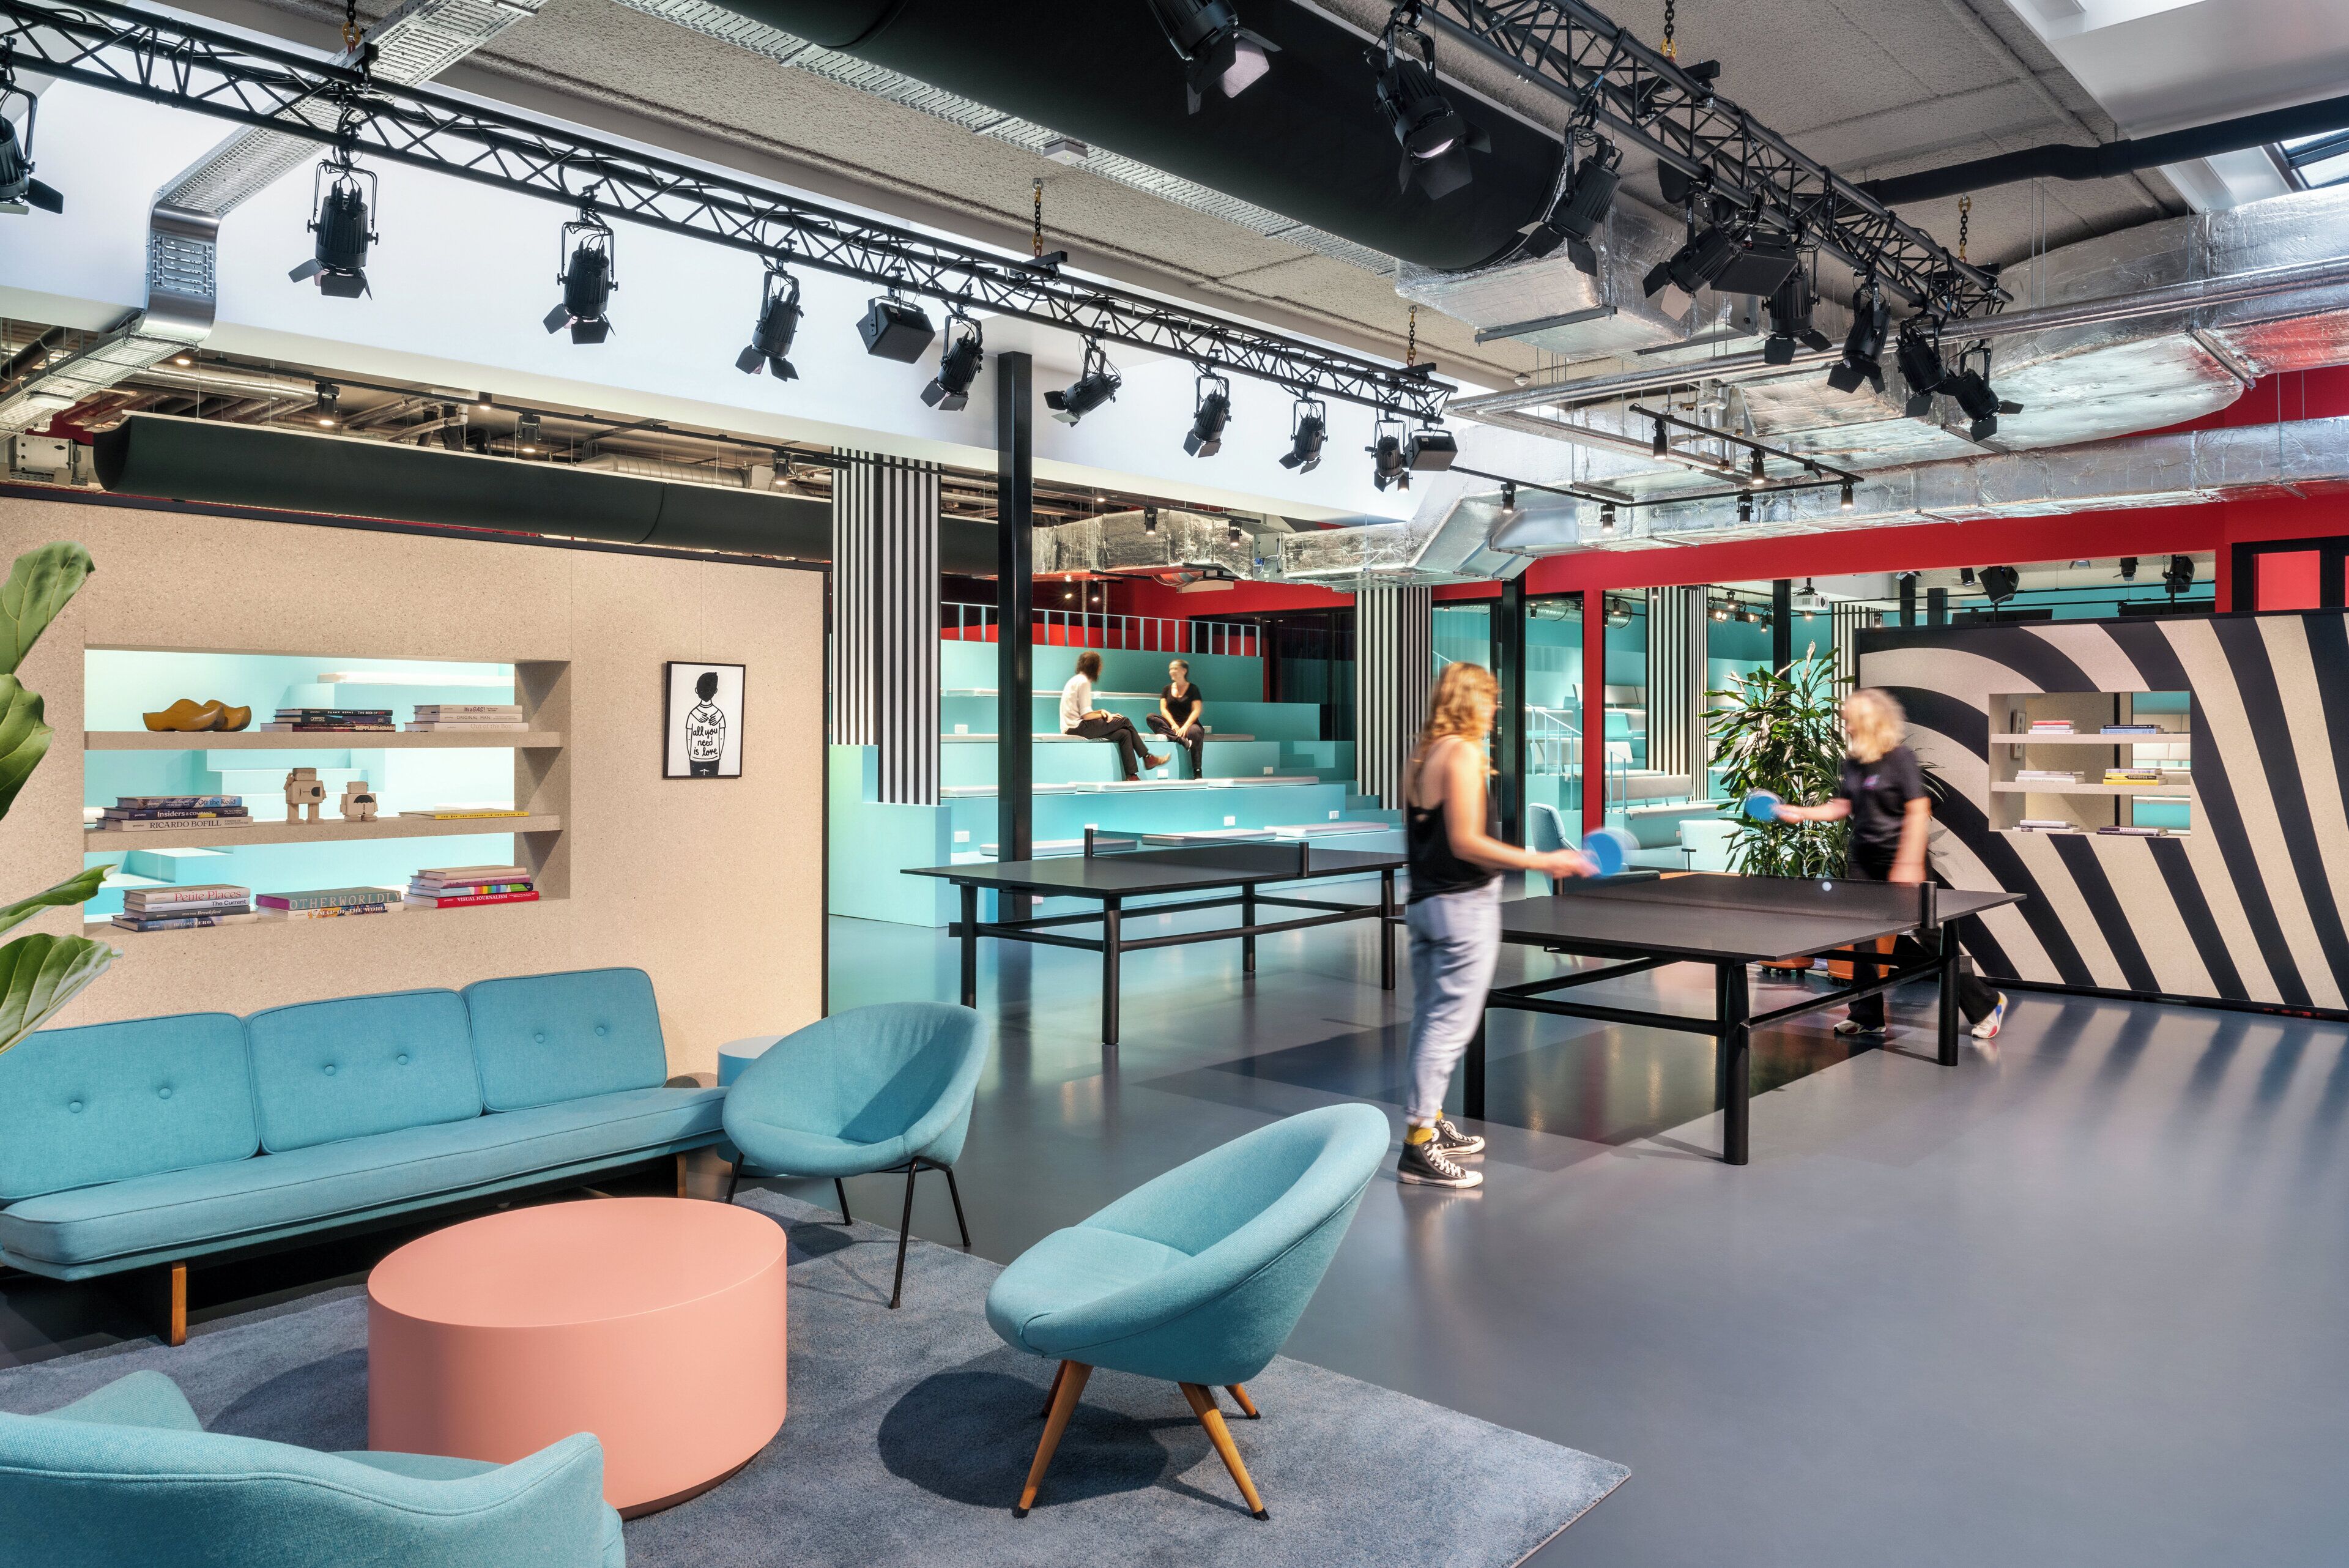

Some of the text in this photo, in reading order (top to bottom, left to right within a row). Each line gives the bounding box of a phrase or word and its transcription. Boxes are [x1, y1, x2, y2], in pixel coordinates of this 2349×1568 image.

[692, 726, 718, 739] all you
[697, 736, 713, 746] need
[694, 746, 718, 757] is love
[174, 892, 204, 901] Petite
[207, 890, 242, 899] Places
[289, 892, 402, 910] OTHERWORLDLY
